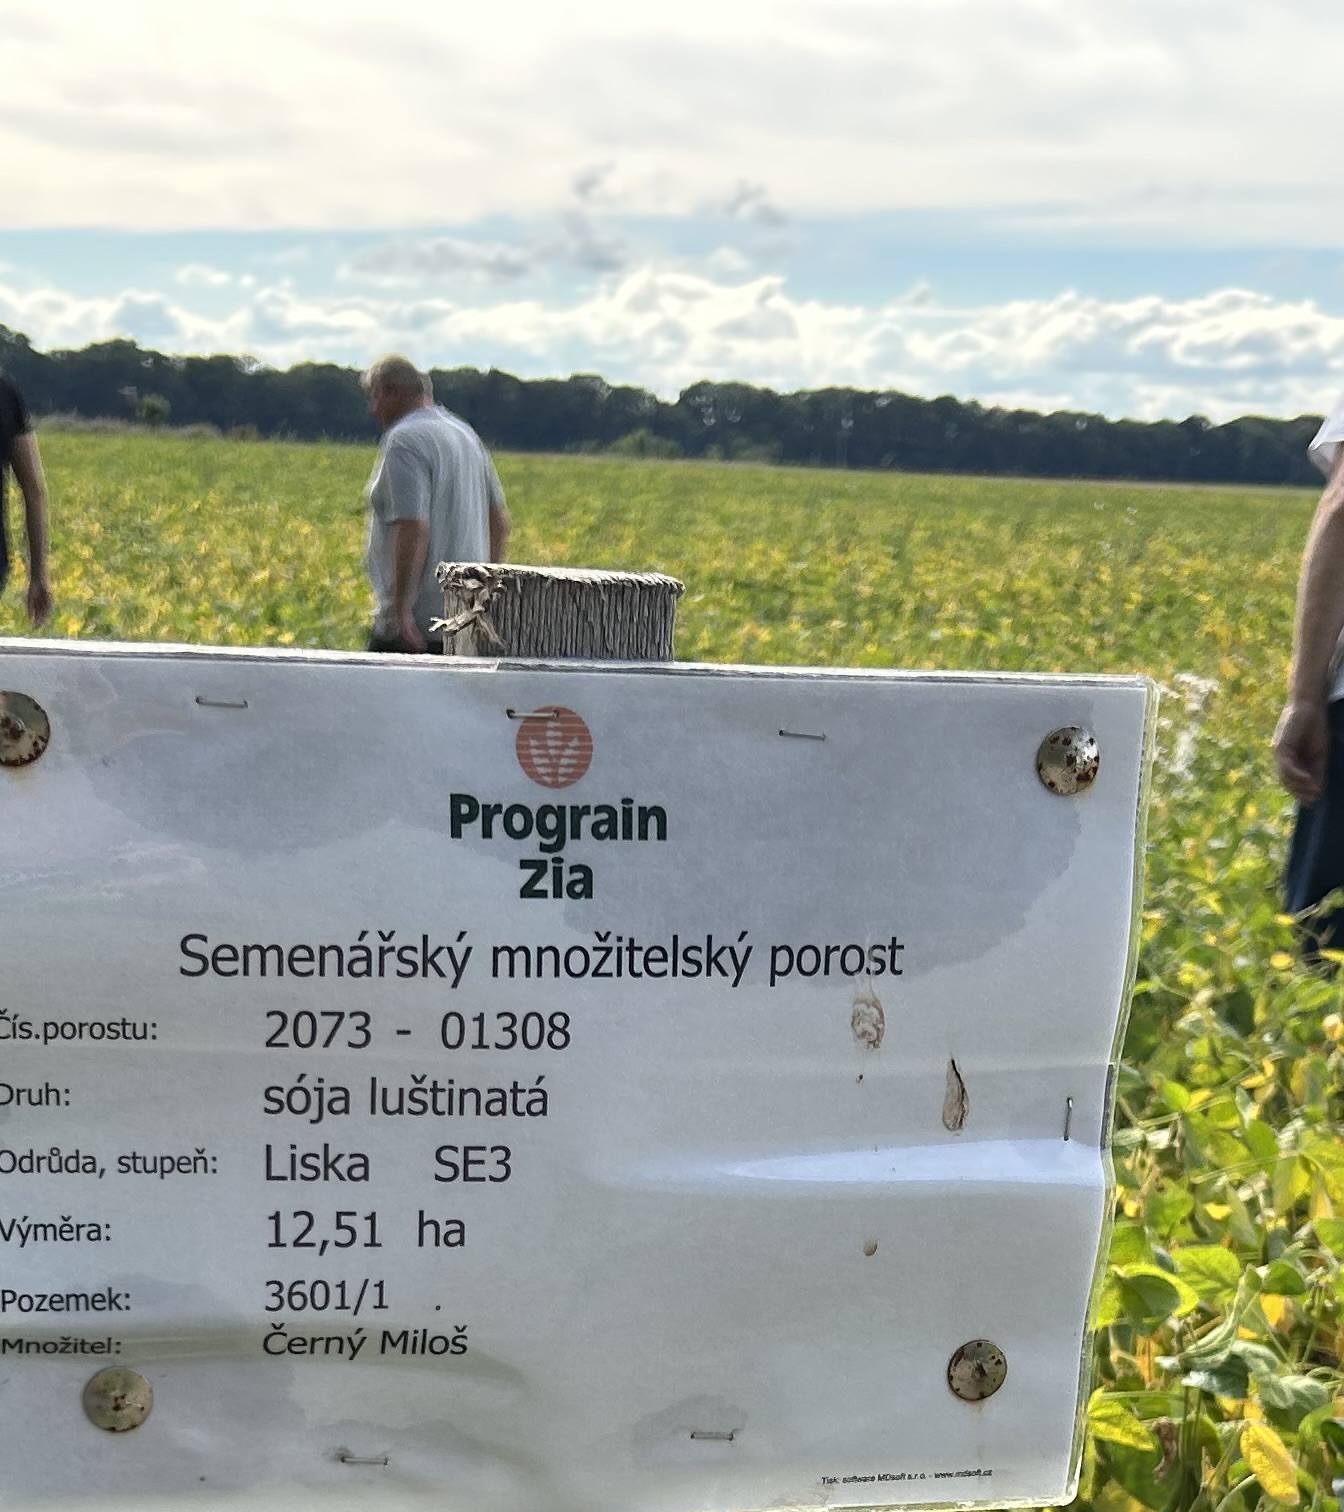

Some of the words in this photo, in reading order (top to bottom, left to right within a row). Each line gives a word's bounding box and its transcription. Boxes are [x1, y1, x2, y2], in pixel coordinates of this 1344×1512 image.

[450, 793, 668, 853] Prograin
[179, 930, 473, 989] Semenářský
[492, 931, 754, 988] množitelský
[769, 936, 905, 988] porost
[265, 1010, 372, 1049] 2073
[441, 1011, 572, 1050] 01308
[263, 1073, 351, 1124] sója
[370, 1074, 549, 1117] luštinatá
[117, 1148, 218, 1180] stupeň:
[265, 1143, 370, 1182] Liska
[434, 1145, 512, 1182] SE3
[267, 1210, 383, 1257] 12,51
[418, 1209, 466, 1247] ha
[1, 1287, 131, 1312] Pozemek:
[264, 1278, 389, 1316] 3601/1
[1, 1336, 122, 1354] Množitel:
[262, 1323, 367, 1360] Černý
[381, 1324, 468, 1355] Miloš
